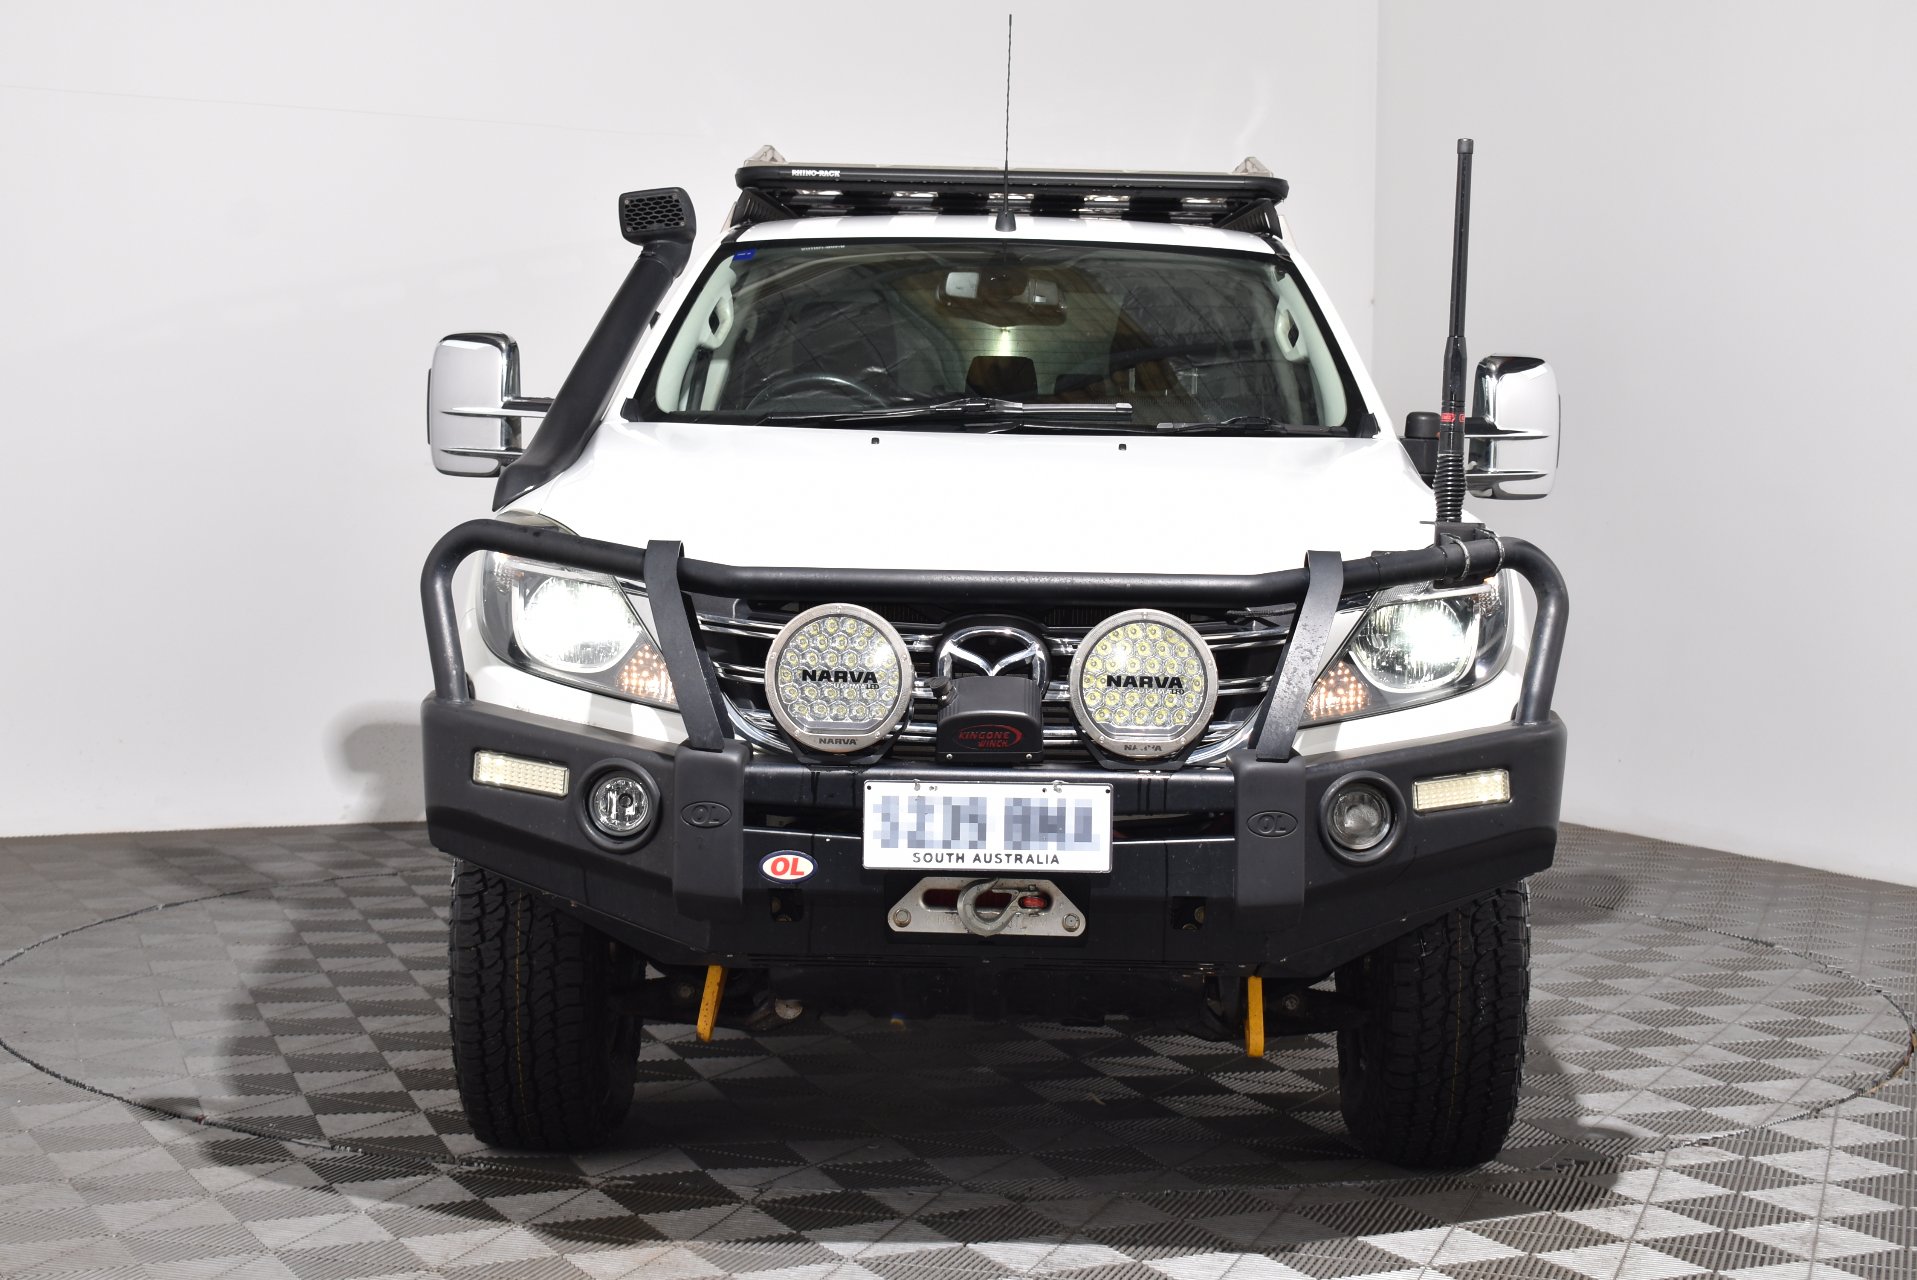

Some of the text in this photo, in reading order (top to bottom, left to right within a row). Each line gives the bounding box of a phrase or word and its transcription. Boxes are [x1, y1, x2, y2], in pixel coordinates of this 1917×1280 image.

[791, 169, 841, 178] RHINO-RACK
[801, 669, 878, 683] NARVA
[1106, 675, 1183, 689] NARVA
[959, 731, 1010, 740] KINGONE
[818, 737, 857, 746] NARVA
[978, 740, 1009, 748] WINCH
[912, 852, 1060, 865] SOUTH AUSTRALIA
[770, 856, 805, 877] OL
